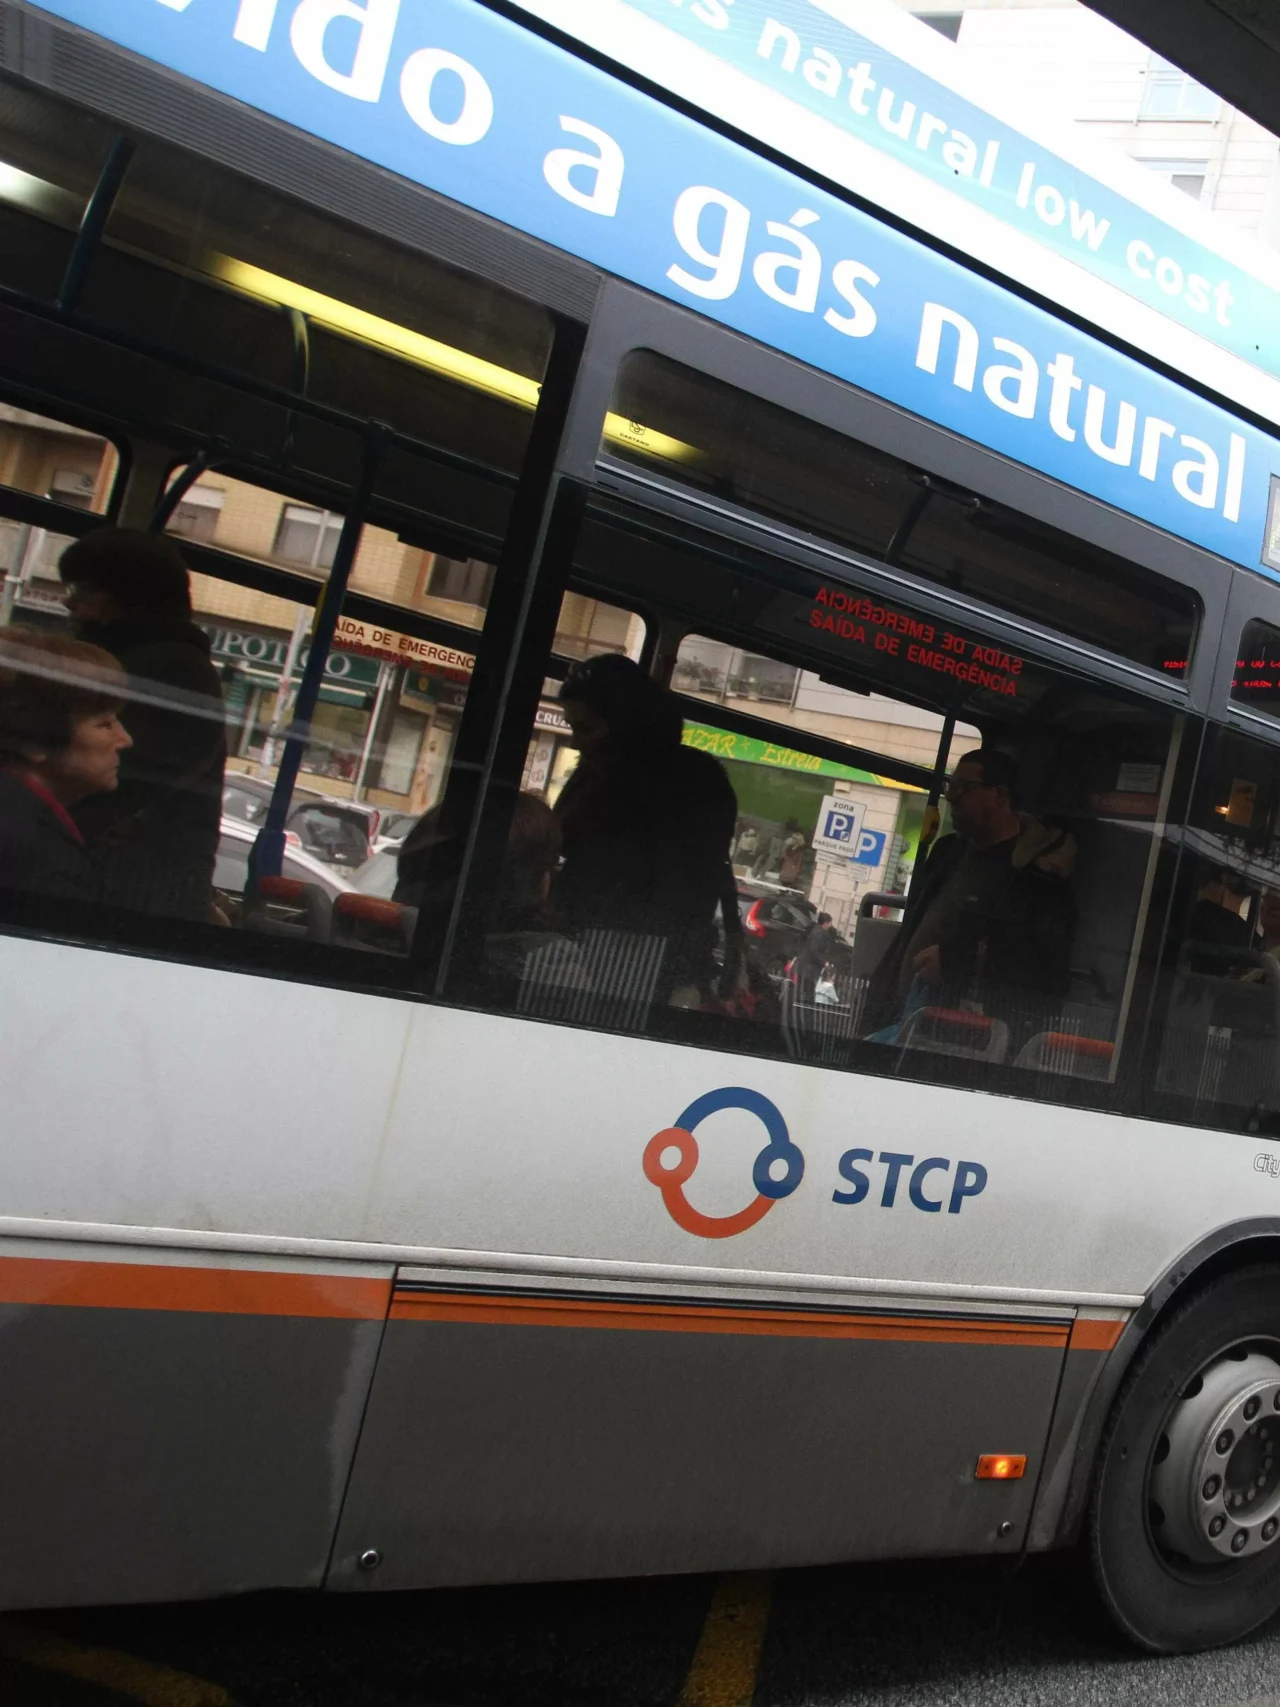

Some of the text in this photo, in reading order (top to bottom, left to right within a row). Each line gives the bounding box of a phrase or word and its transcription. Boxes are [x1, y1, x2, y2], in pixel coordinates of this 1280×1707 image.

[757, 17, 1000, 188] natural
[1016, 162, 1111, 251] low
[1126, 239, 1236, 327] cost
[543, 115, 625, 217] a
[666, 186, 881, 337] gás
[915, 302, 1246, 523] natural
[372, 630, 392, 645] DE
[809, 609, 1017, 696] SAÍDA DE EMERGÊNCIA
[681, 727, 736, 759] AZAR
[833, 801, 855, 812] zona
[828, 813, 848, 837] P
[854, 833, 877, 859] P
[831, 1147, 988, 1214] STCP
